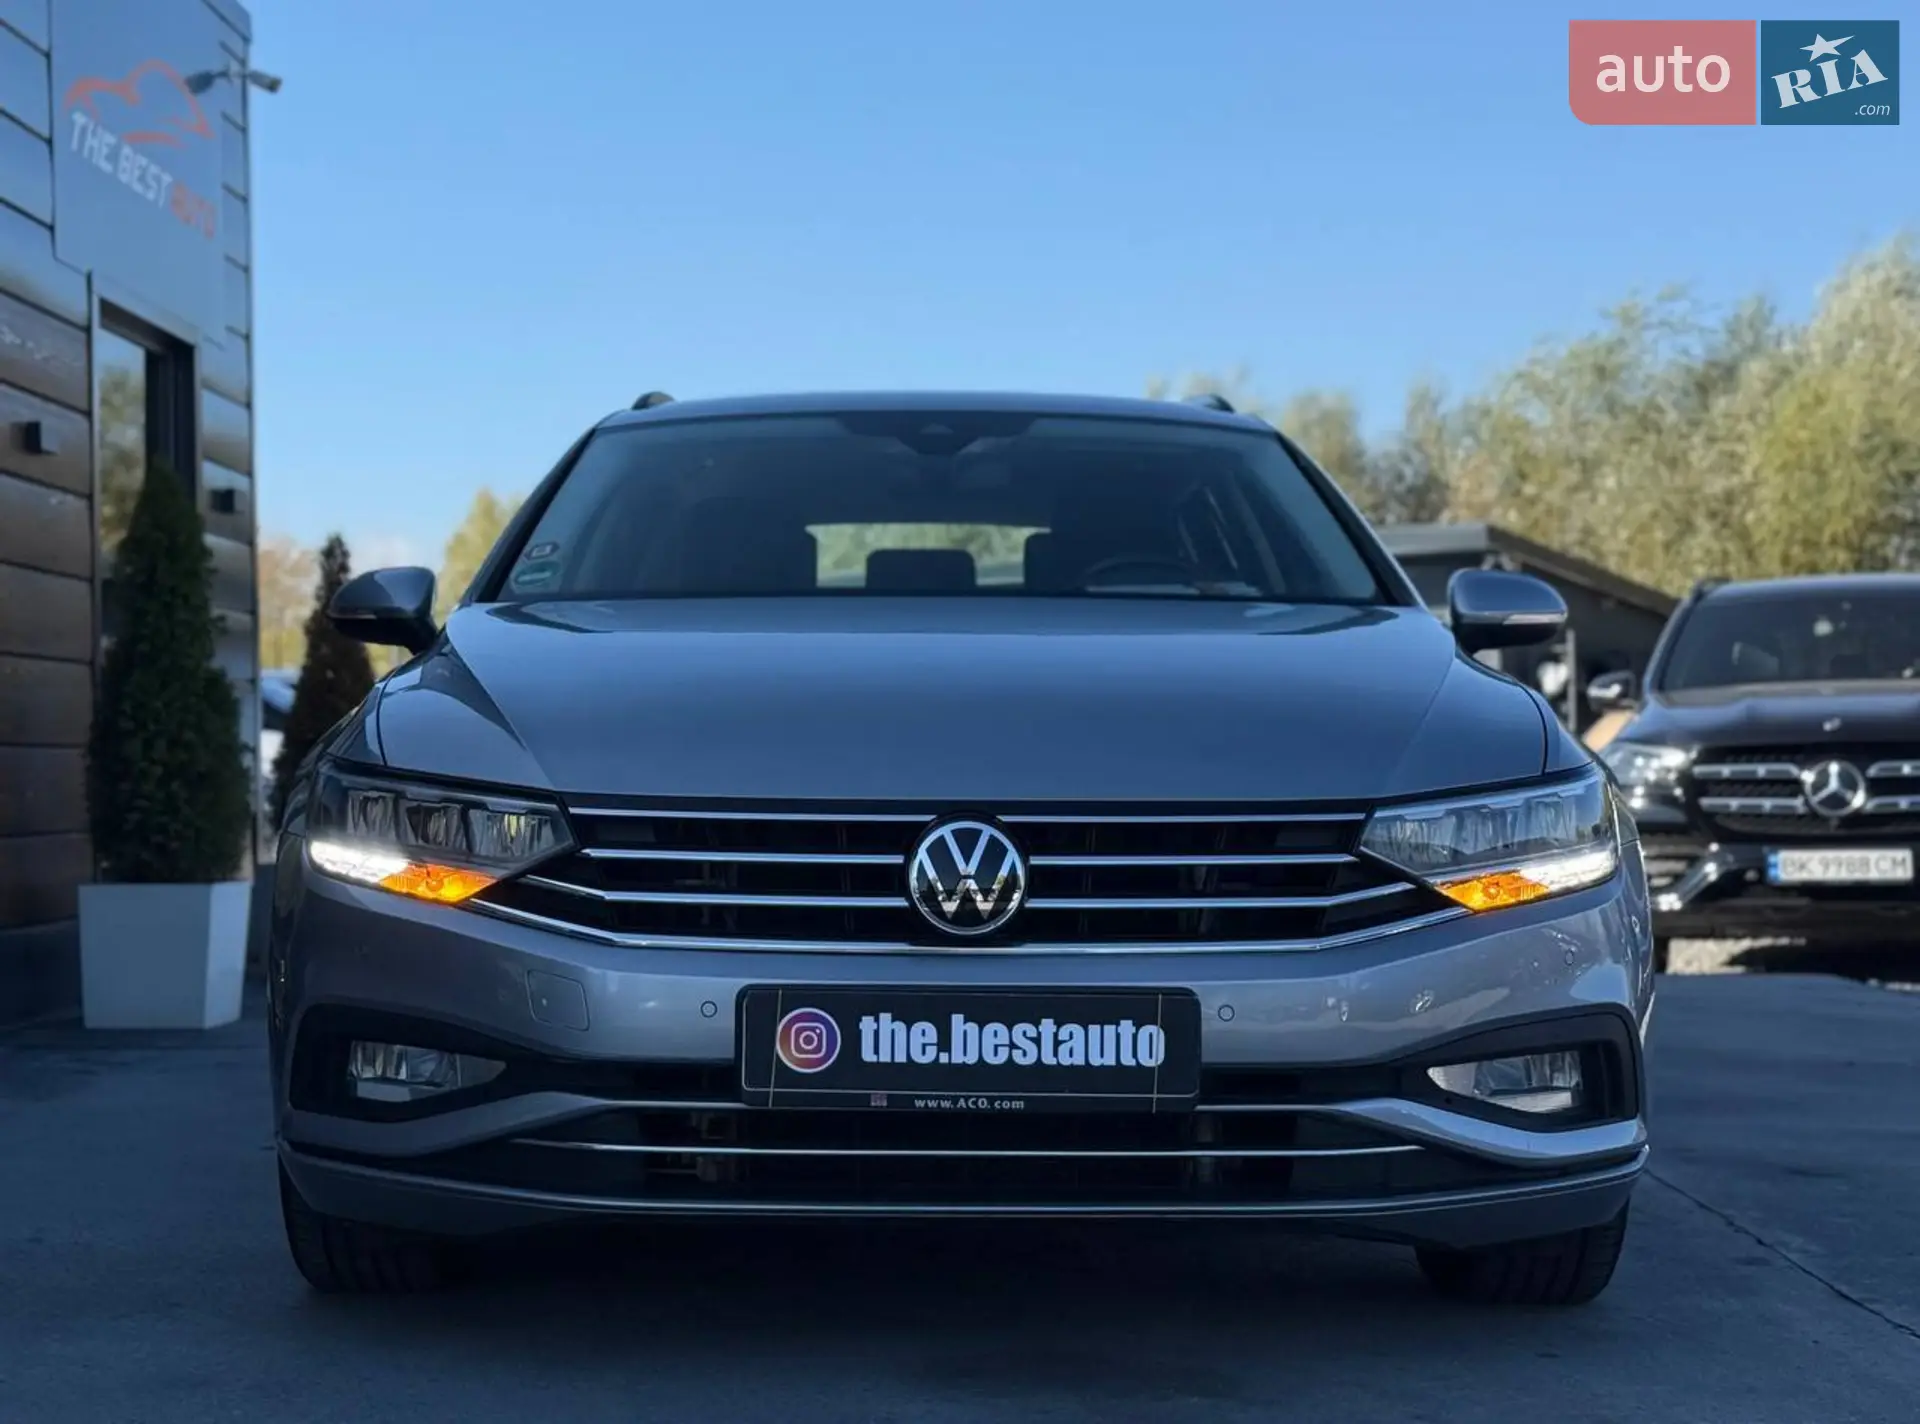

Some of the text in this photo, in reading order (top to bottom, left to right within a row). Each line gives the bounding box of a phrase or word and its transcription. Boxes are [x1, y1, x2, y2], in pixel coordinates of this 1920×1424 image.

[70, 111, 117, 174] THE
[117, 144, 173, 208] BEST
[859, 1013, 1165, 1066] the.bestauto
